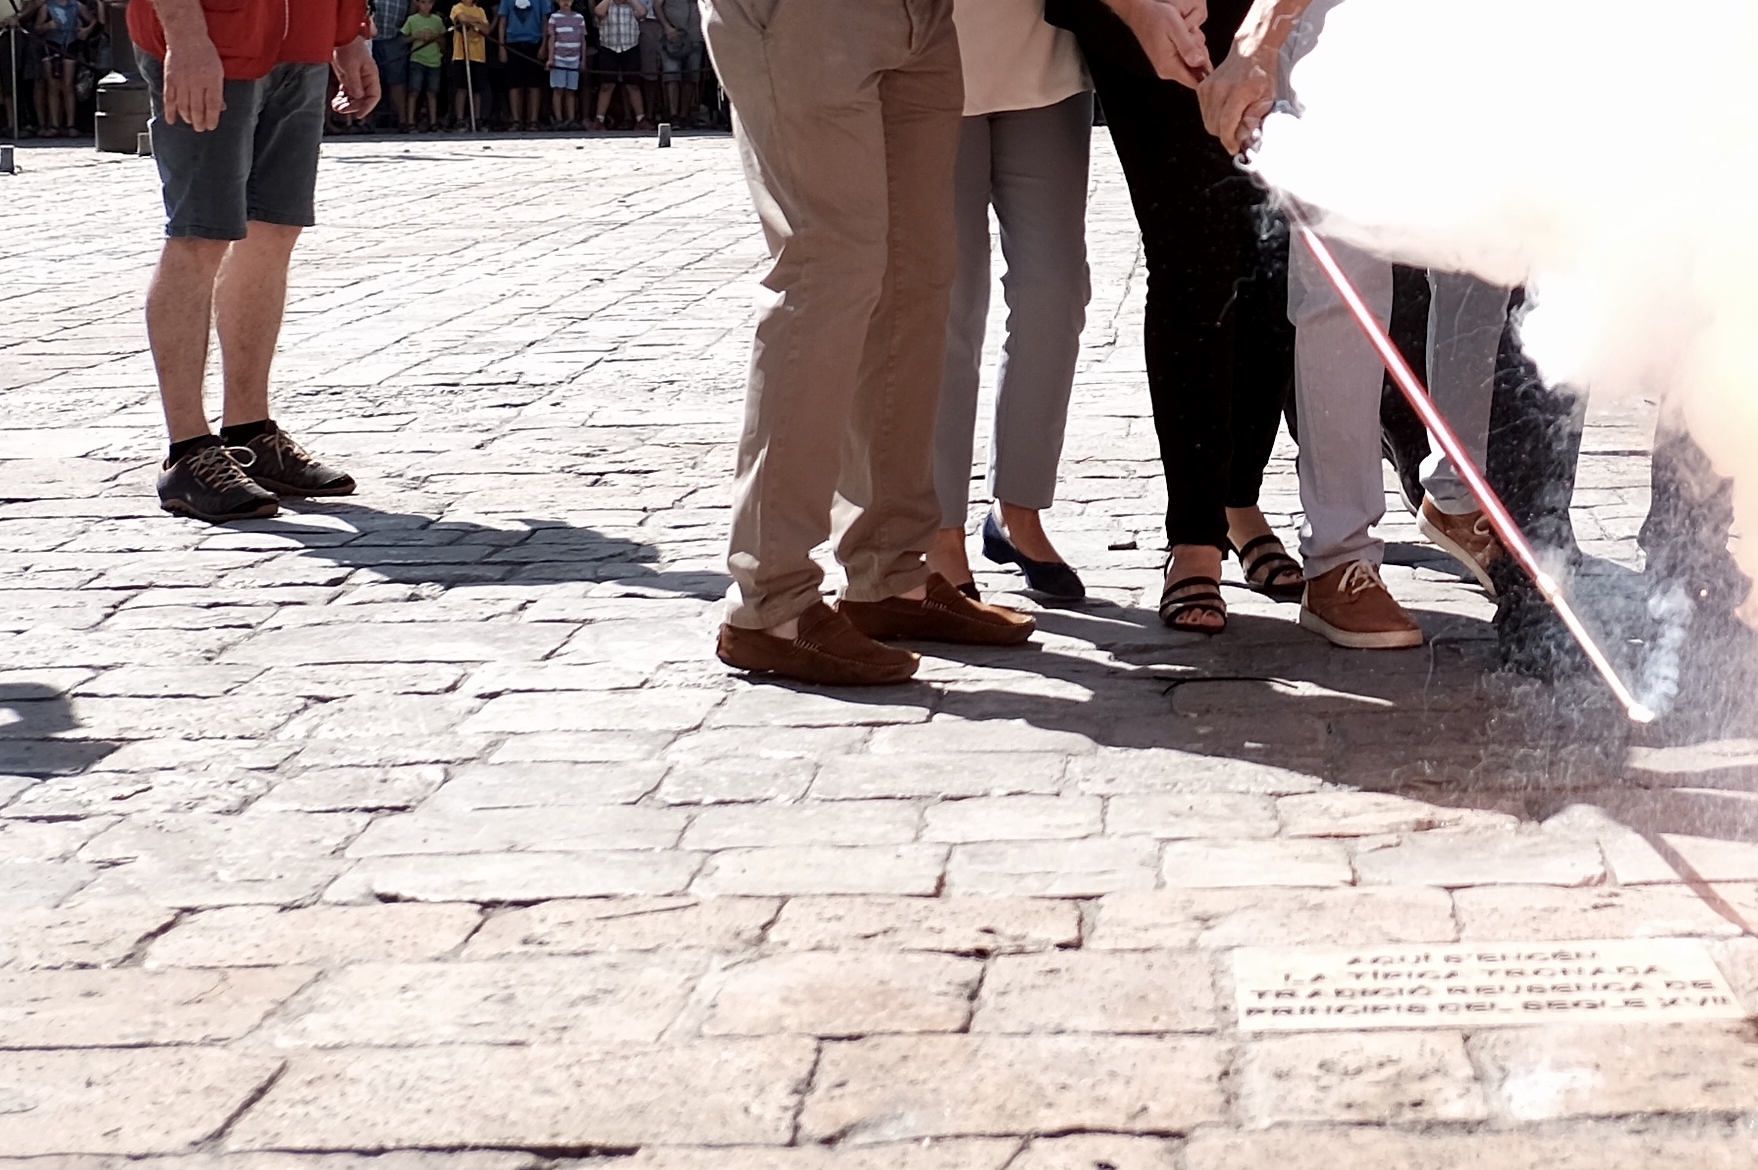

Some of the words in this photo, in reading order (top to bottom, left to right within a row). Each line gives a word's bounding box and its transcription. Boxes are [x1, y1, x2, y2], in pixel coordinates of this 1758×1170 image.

[1284, 972, 1330, 985] LA
[1480, 964, 1667, 978] TRONADA
[1249, 984, 1433, 1000] TRADICIÓ
[1446, 981, 1649, 996] REUSENCA
[1664, 979, 1715, 991] DE
[1245, 1002, 1427, 1017] PRINCIPIS
[1437, 1001, 1514, 1014] DEL
[1522, 997, 1647, 1012] SEGLE
